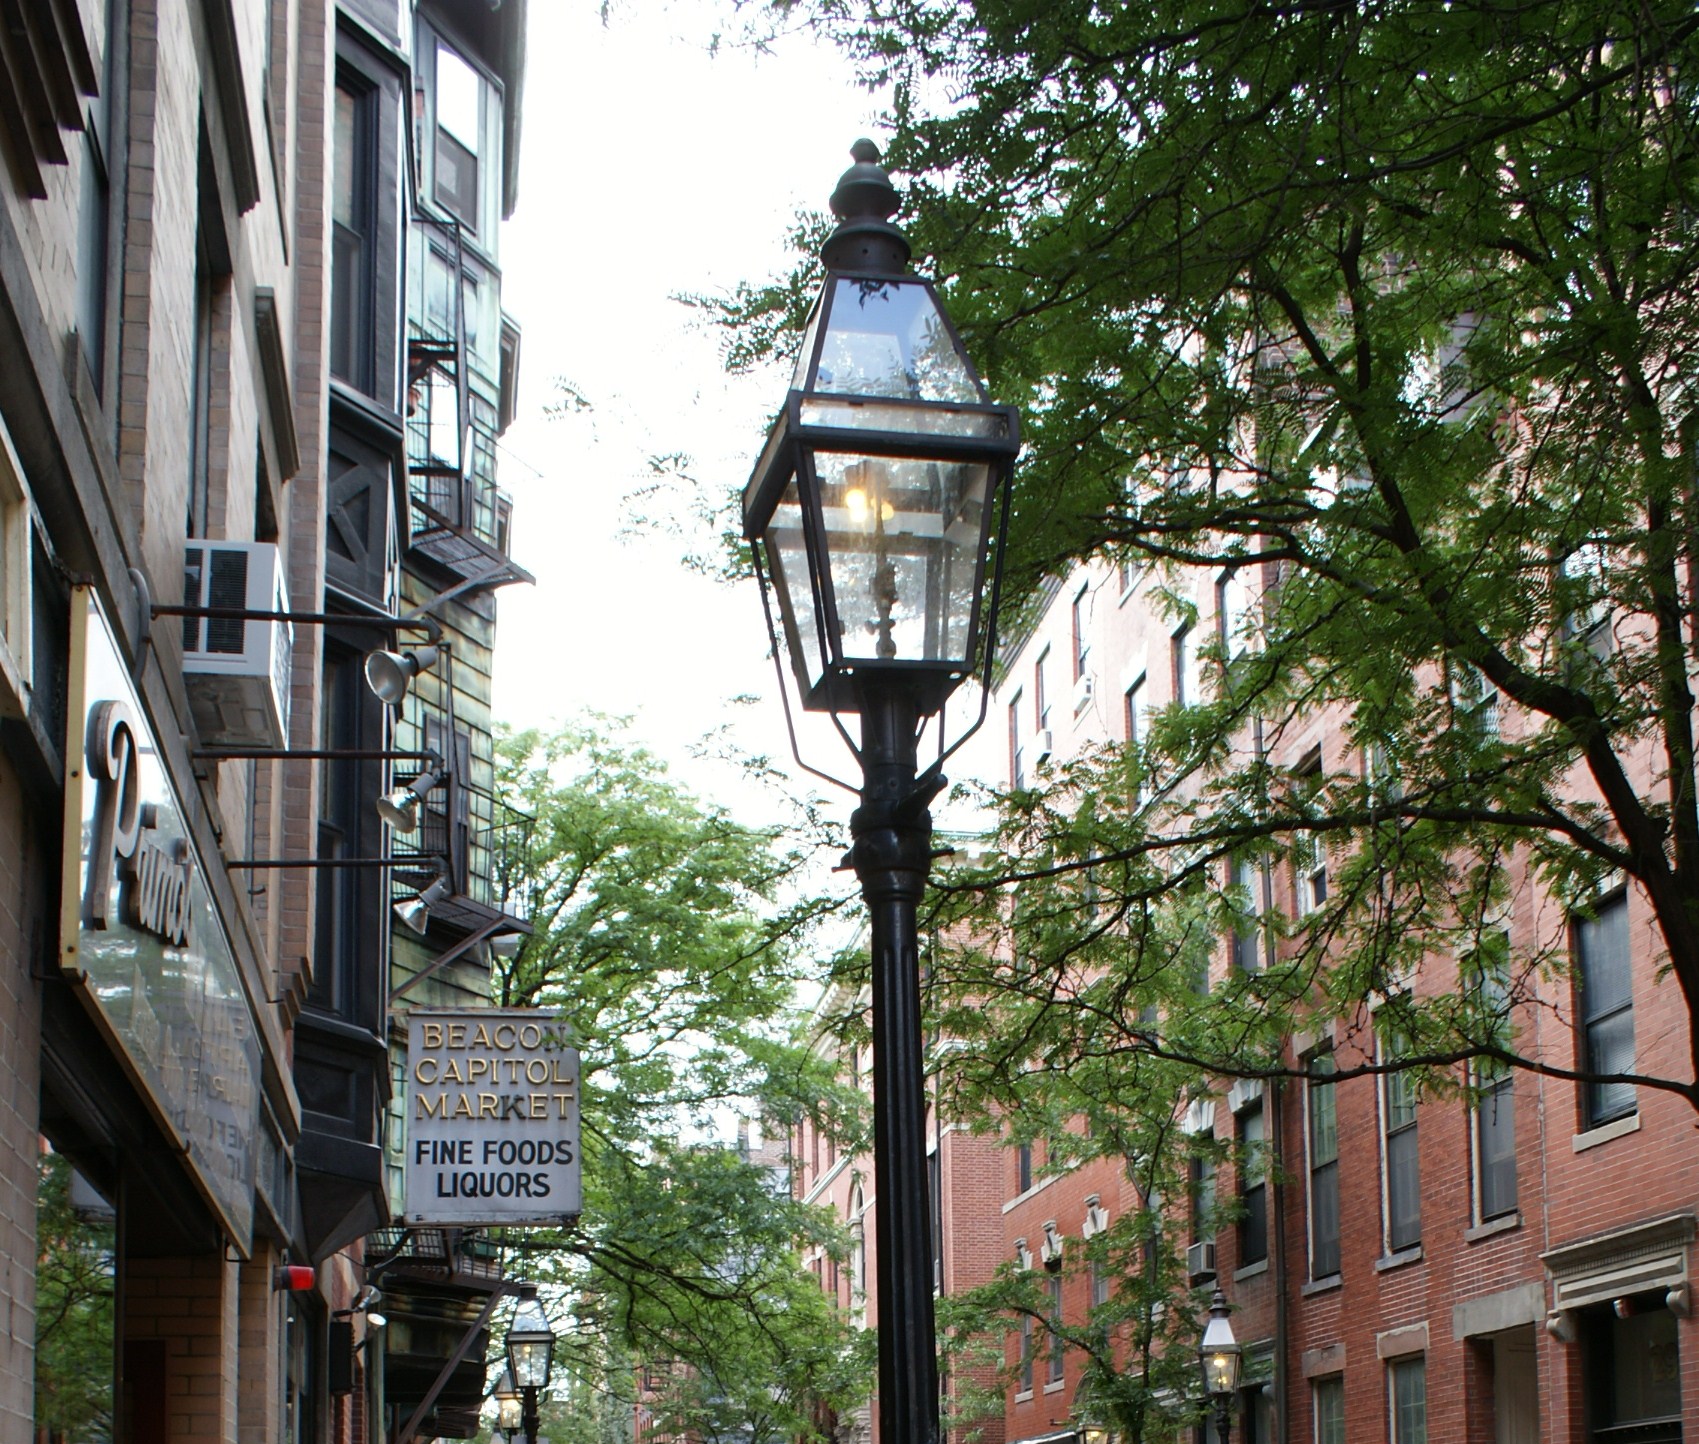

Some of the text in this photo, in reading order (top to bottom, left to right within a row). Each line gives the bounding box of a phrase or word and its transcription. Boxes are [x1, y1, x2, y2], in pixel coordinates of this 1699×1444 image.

[422, 1023, 567, 1051] BEACON
[415, 1058, 573, 1085] CAPITOL
[415, 1093, 574, 1120] MARKET
[416, 1140, 573, 1165] FINE FOODS
[437, 1172, 550, 1198] LIQUORS
